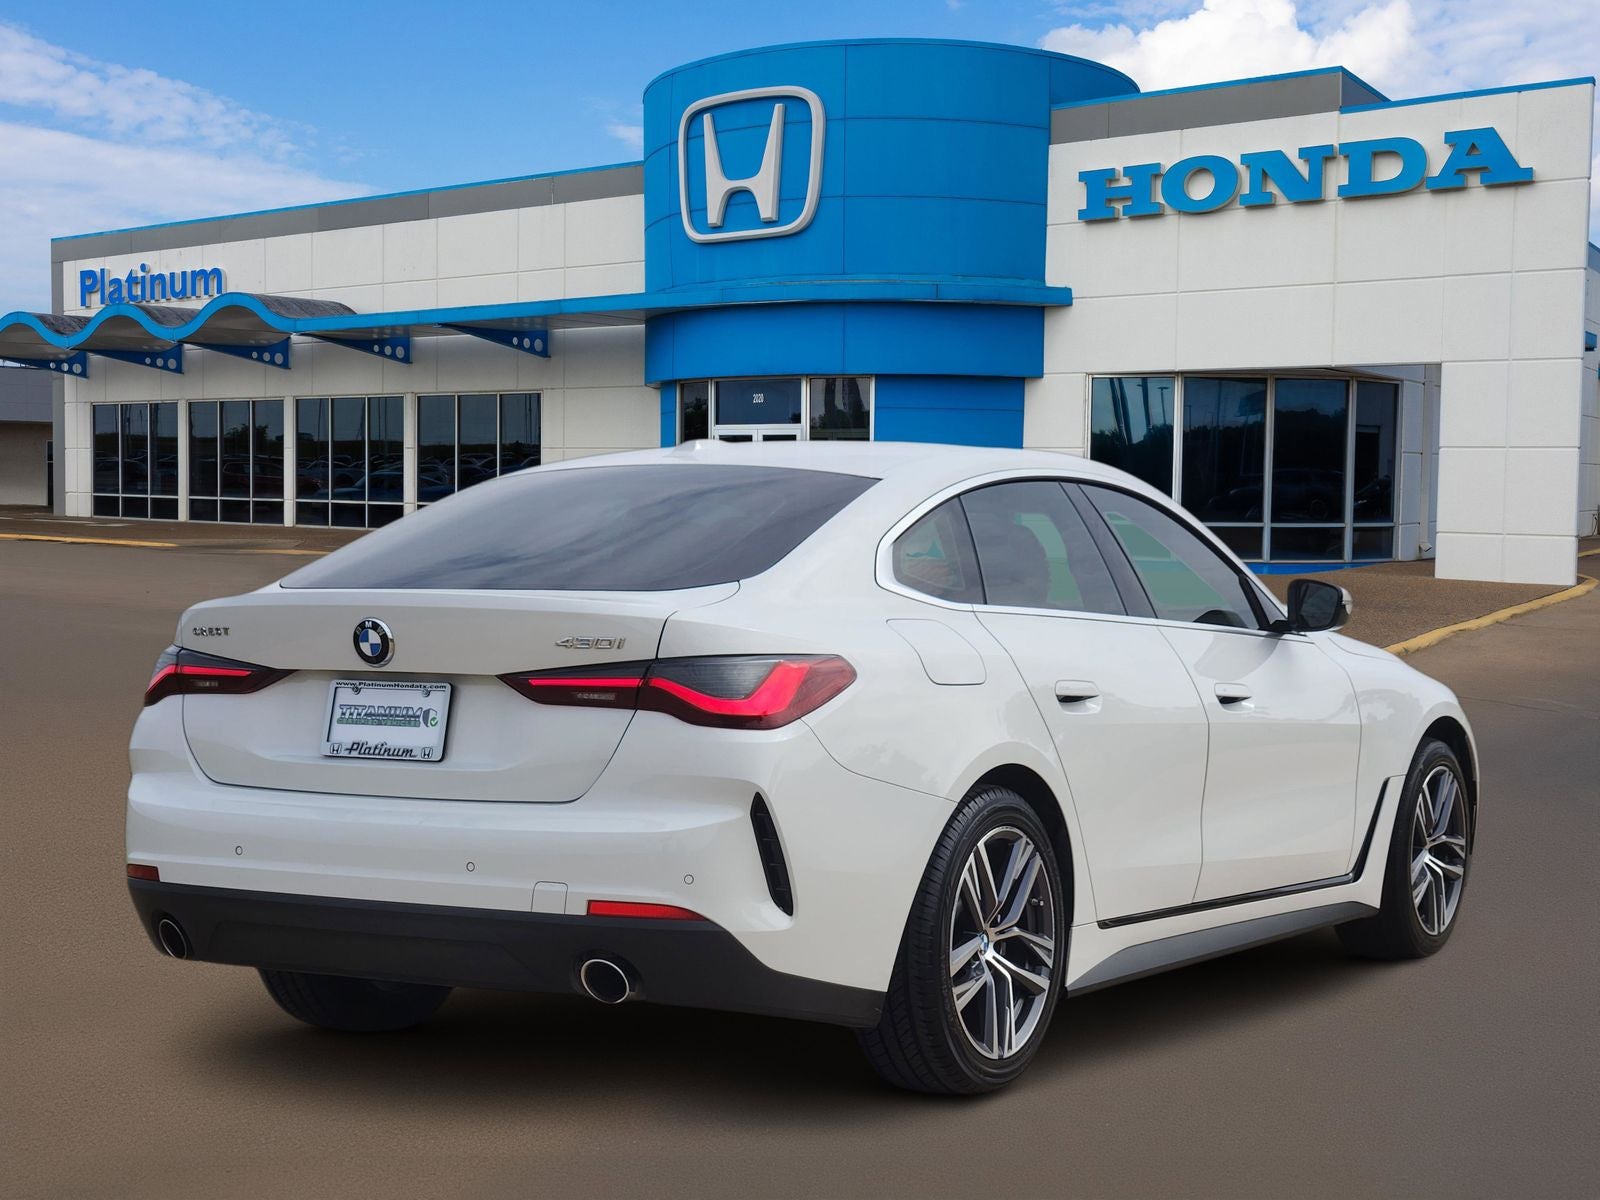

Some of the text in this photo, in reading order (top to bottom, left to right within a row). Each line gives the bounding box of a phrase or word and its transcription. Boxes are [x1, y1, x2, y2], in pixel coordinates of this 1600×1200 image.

[1077, 126, 1535, 223] HONDA
[79, 263, 226, 307] Platinum
[355, 620, 386, 636] BMW
[336, 681, 447, 690] www.PlatinumHondatx.com
[339, 704, 422, 720] TITANIUM
[344, 741, 418, 758] Platinum
